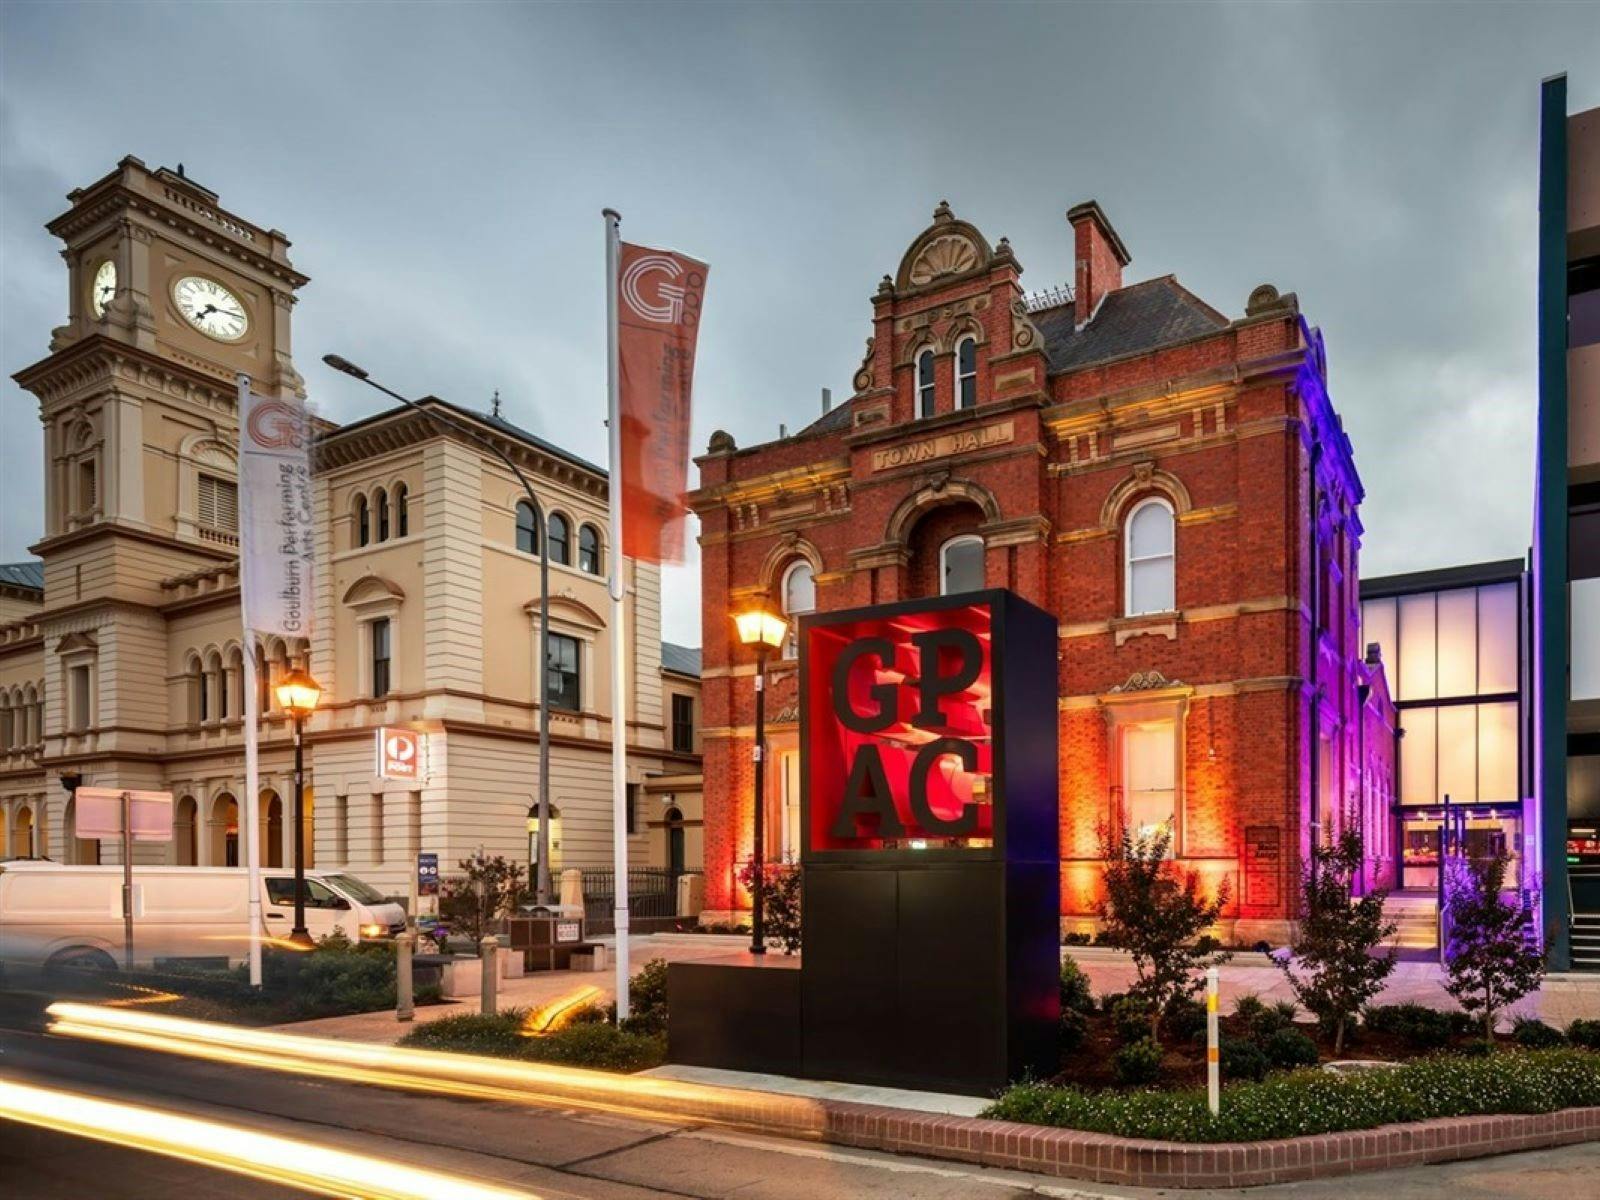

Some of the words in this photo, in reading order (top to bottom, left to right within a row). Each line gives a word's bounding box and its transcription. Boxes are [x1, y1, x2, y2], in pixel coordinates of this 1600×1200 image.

[874, 441, 936, 468] TOWN
[952, 423, 1010, 450] HALL
[276, 463, 298, 555] Performing
[297, 465, 313, 524] Centre
[300, 529, 316, 562] Arts
[280, 560, 302, 632] Goulburn
[831, 738, 979, 839] AC
